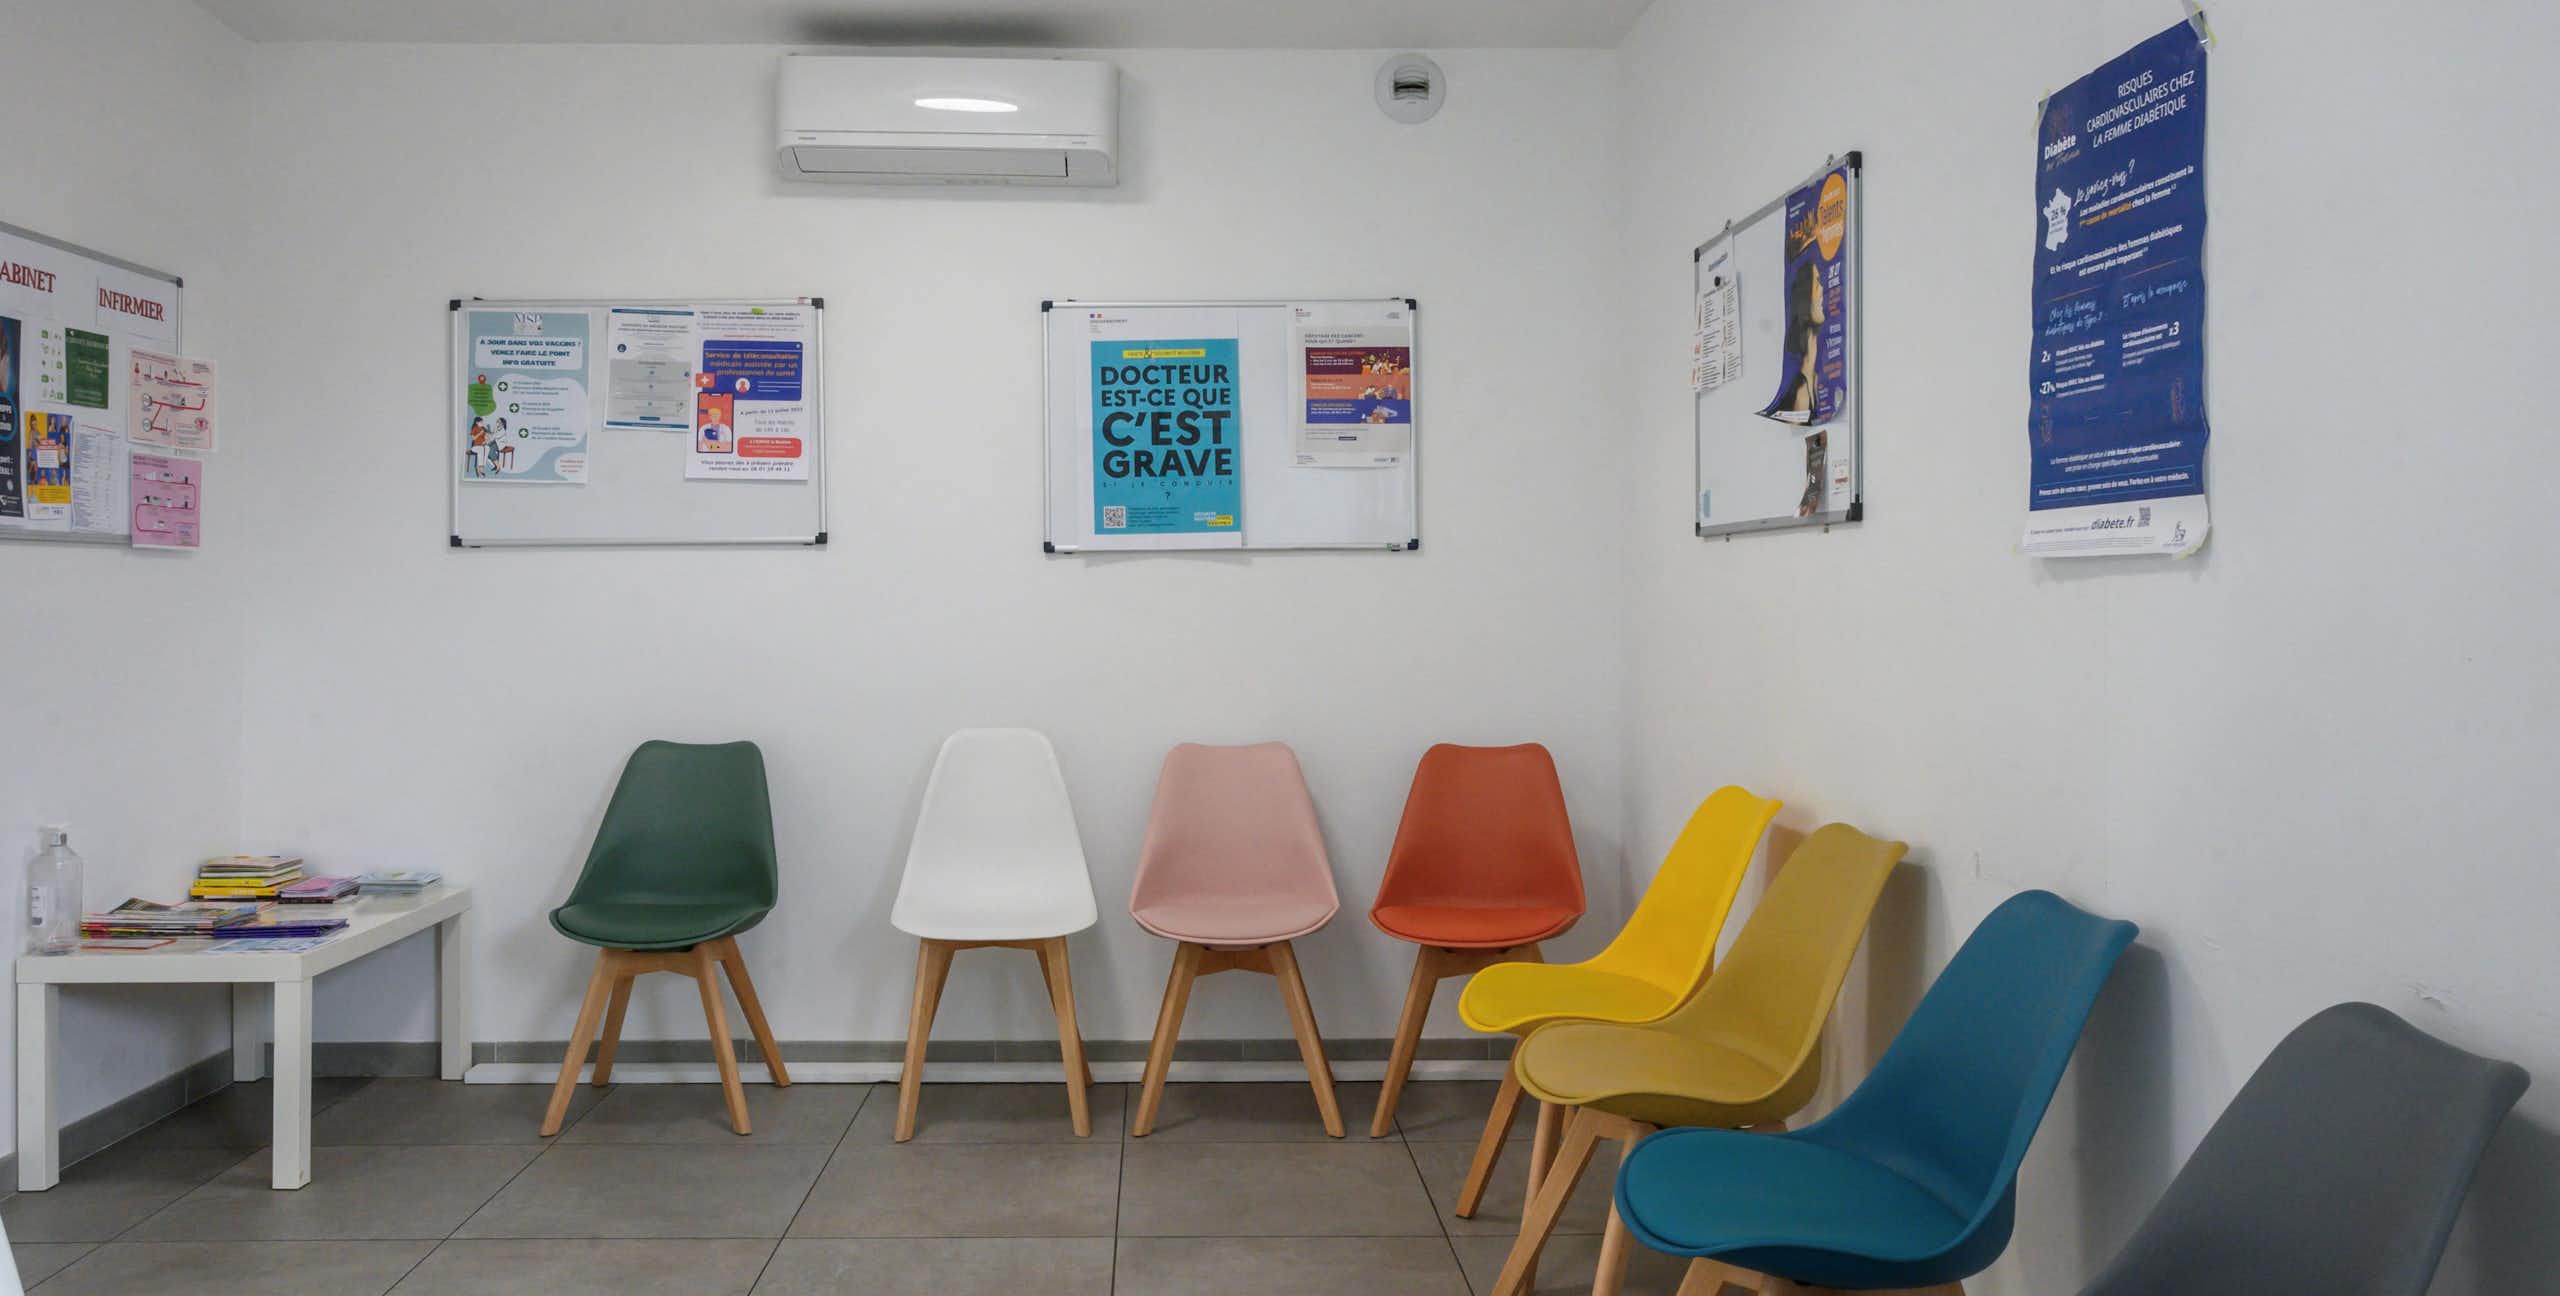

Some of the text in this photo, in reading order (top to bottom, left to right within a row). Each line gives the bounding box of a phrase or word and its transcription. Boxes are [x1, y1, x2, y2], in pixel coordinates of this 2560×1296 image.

[2117, 69, 2153, 98] RISQUES
[2086, 69, 2195, 133] CARDIOVASCULAIRES CHEZ
[2092, 94, 2187, 148] LA FEMME DIABÉTIQUE
[2044, 134, 2077, 160] Diabète
[99, 288, 164, 321] INFIRMIER
[705, 352, 731, 360] Service
[732, 352, 741, 360] de
[1100, 364, 1230, 386] DOCTEUR
[1101, 387, 1231, 410] EST-CE QUE
[1102, 410, 1231, 447] C'EST
[1103, 448, 1233, 478] GRAVE
